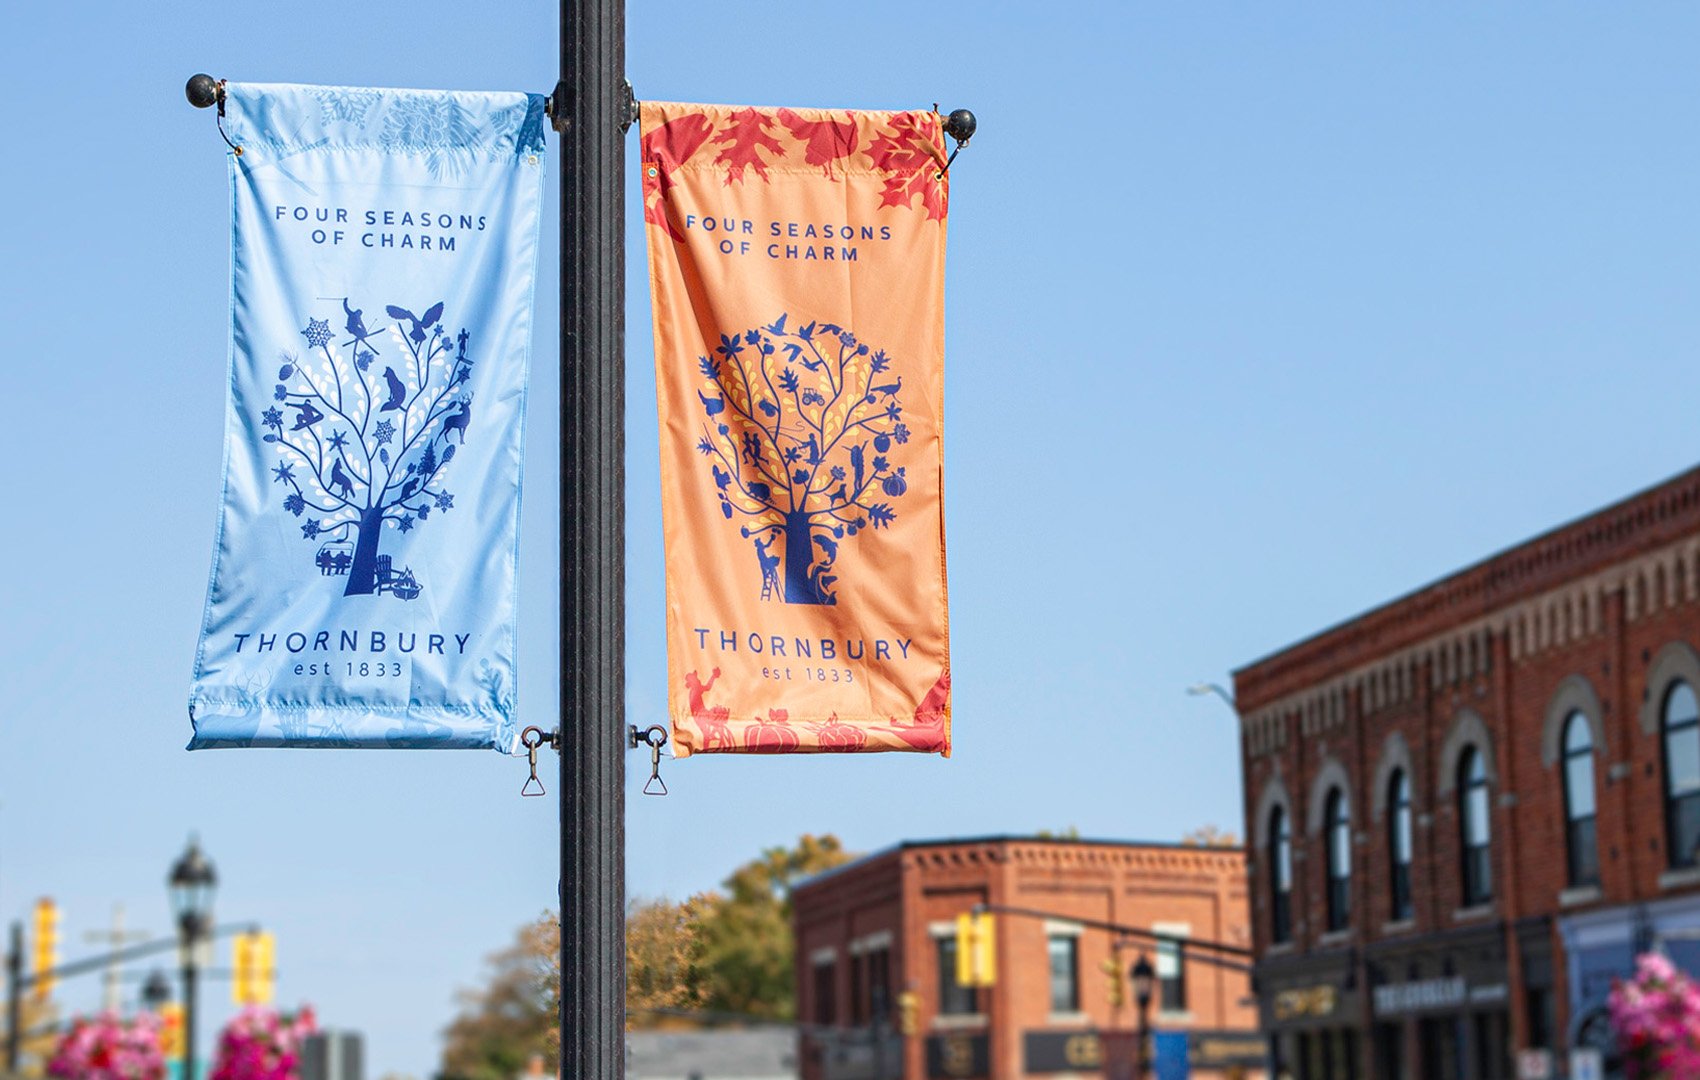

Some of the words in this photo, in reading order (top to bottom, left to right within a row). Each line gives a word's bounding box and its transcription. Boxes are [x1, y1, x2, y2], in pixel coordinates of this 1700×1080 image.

[275, 205, 349, 223] FOUR
[365, 210, 487, 231] SEASONS
[685, 214, 754, 234] FOUR
[770, 221, 892, 241] SEASONS
[311, 229, 345, 245] OF
[361, 232, 456, 252] CHARM
[719, 239, 751, 255] OF
[767, 243, 858, 262] CHARM
[233, 630, 471, 655] THORNBURY
[694, 628, 912, 660] THORNBURY
[293, 661, 331, 676] est
[346, 662, 402, 677] 1833
[762, 667, 792, 681] est
[806, 667, 853, 683] 1833
